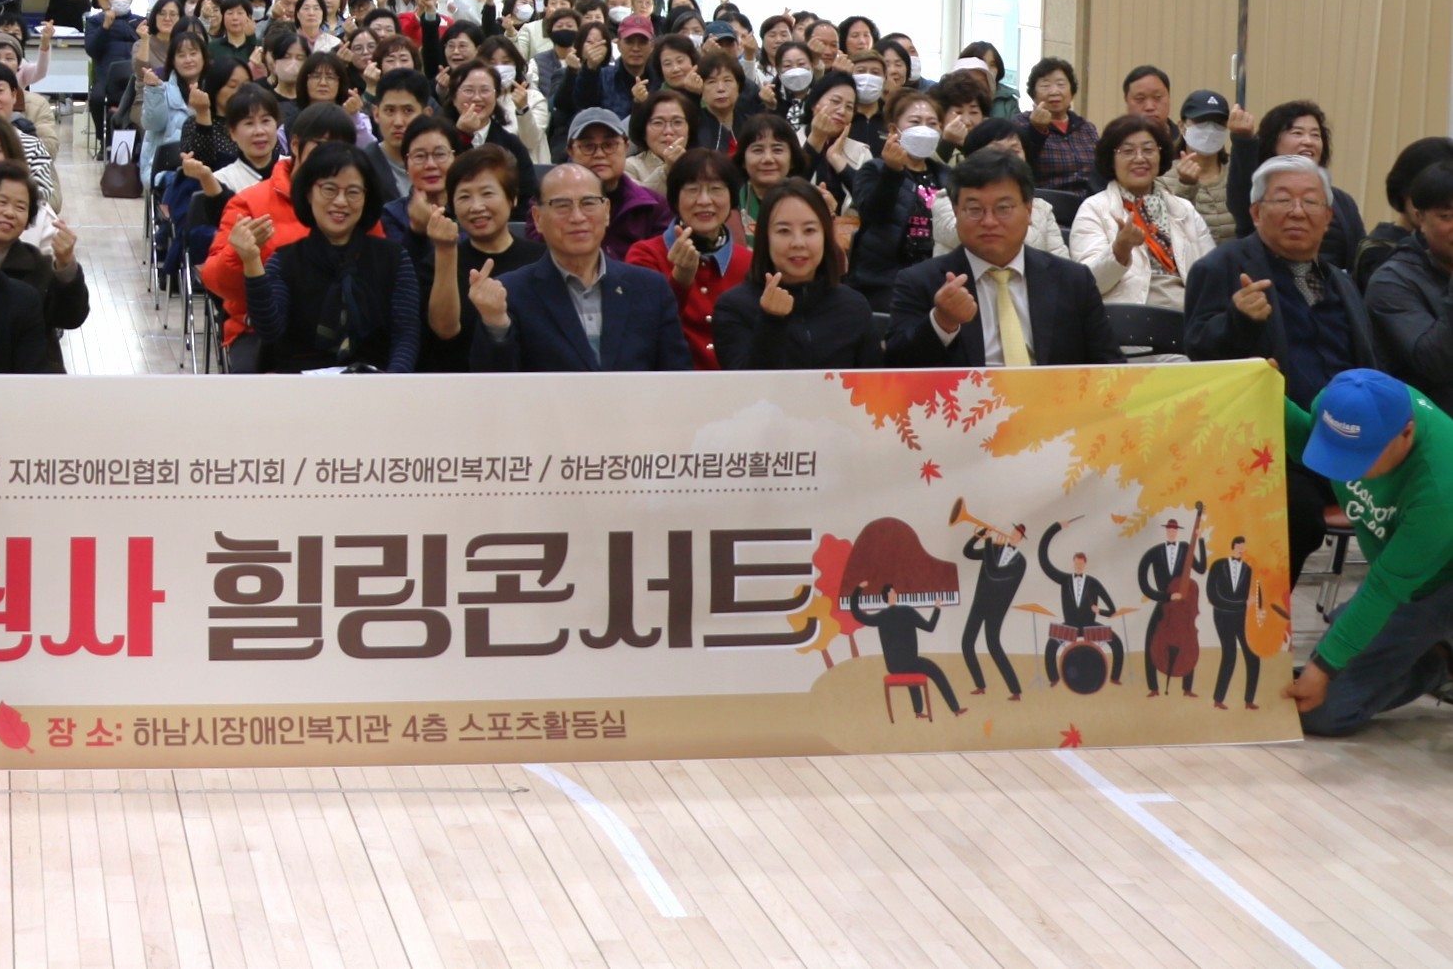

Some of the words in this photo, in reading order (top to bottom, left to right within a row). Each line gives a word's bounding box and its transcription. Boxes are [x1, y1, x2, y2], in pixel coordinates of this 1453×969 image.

[9, 459, 179, 485] 지체장애인협회
[190, 459, 284, 484] 하남지회
[316, 456, 532, 484] 하남시장애인복지관
[561, 451, 816, 481] 하남장애인자립생활센터
[207, 528, 818, 661] 힐링콘서트
[134, 715, 390, 746] 하남시장애인복지관
[402, 714, 447, 742] 4층
[459, 710, 626, 741] 스포츠활동실
